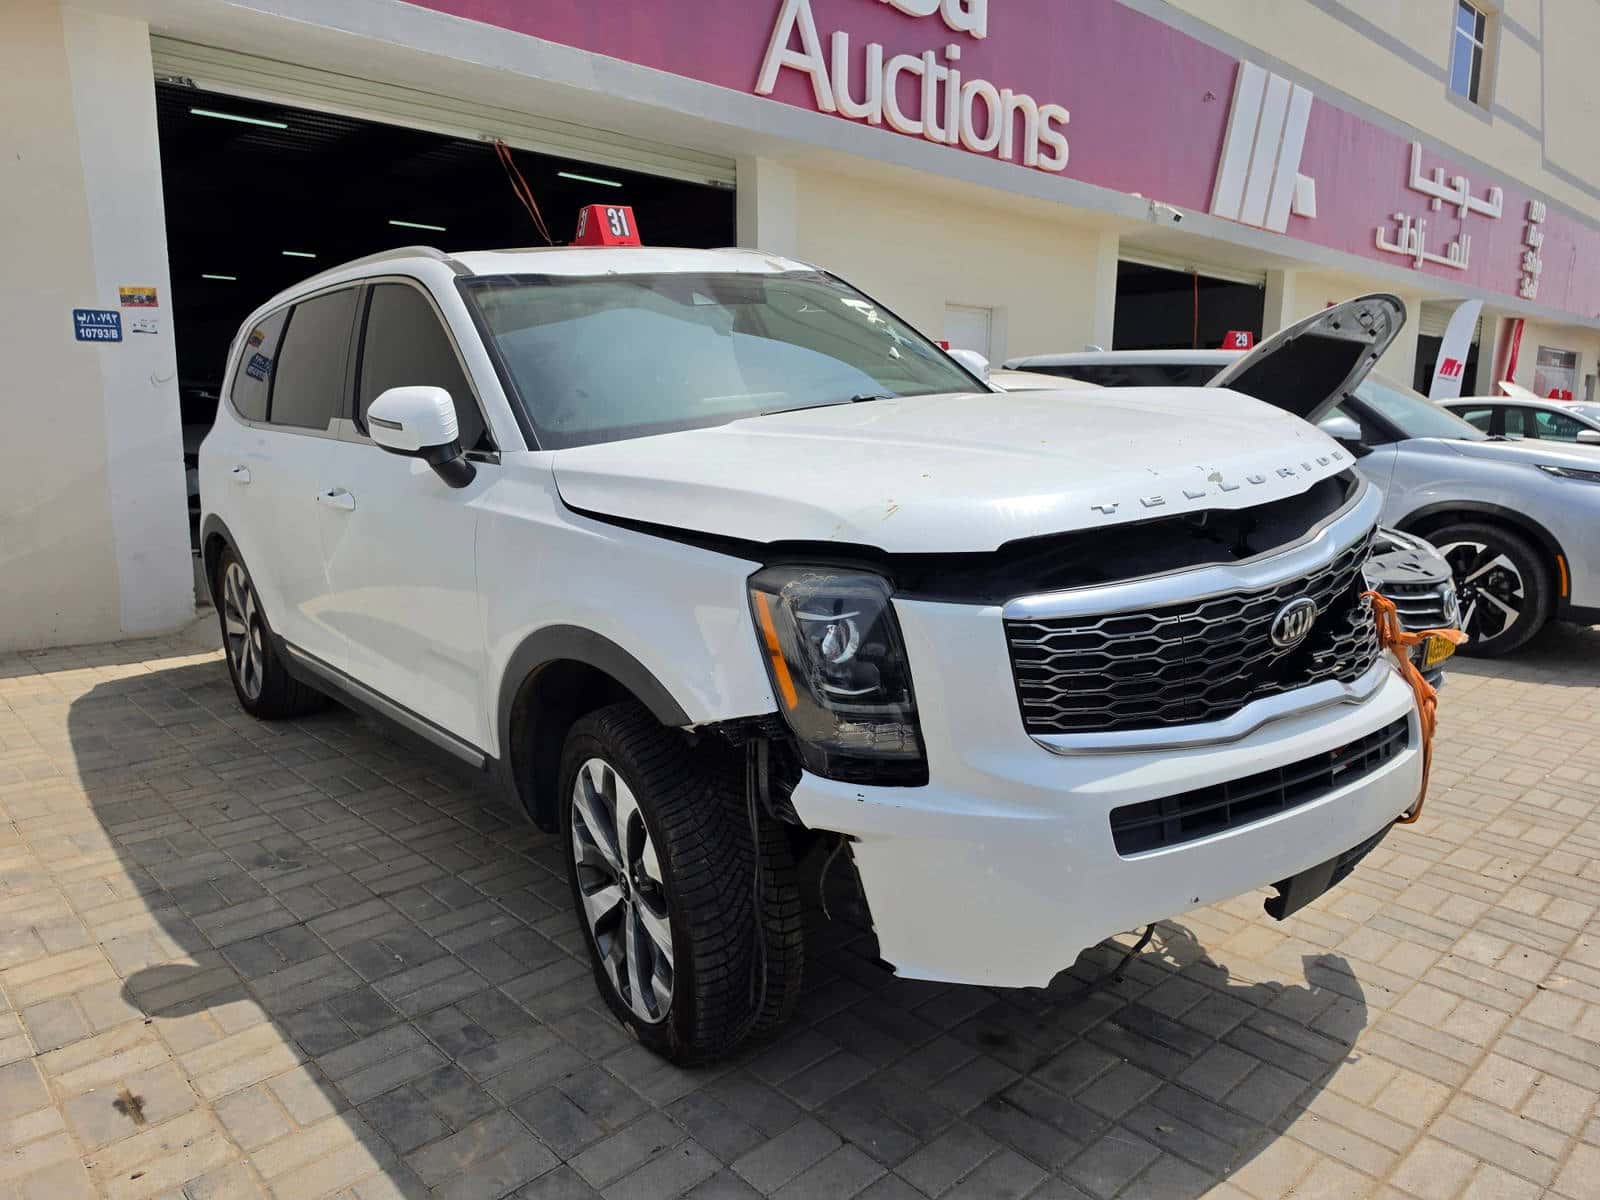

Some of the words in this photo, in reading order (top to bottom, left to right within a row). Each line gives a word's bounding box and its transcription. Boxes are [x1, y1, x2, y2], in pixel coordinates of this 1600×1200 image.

[754, 0, 1070, 171] Auctions
[607, 207, 630, 237] 31
[80, 328, 118, 339] 10793/B
[1236, 333, 1248, 347] 29
[1091, 450, 1343, 514] TELLURIDE
[1282, 606, 1313, 641] KIA
